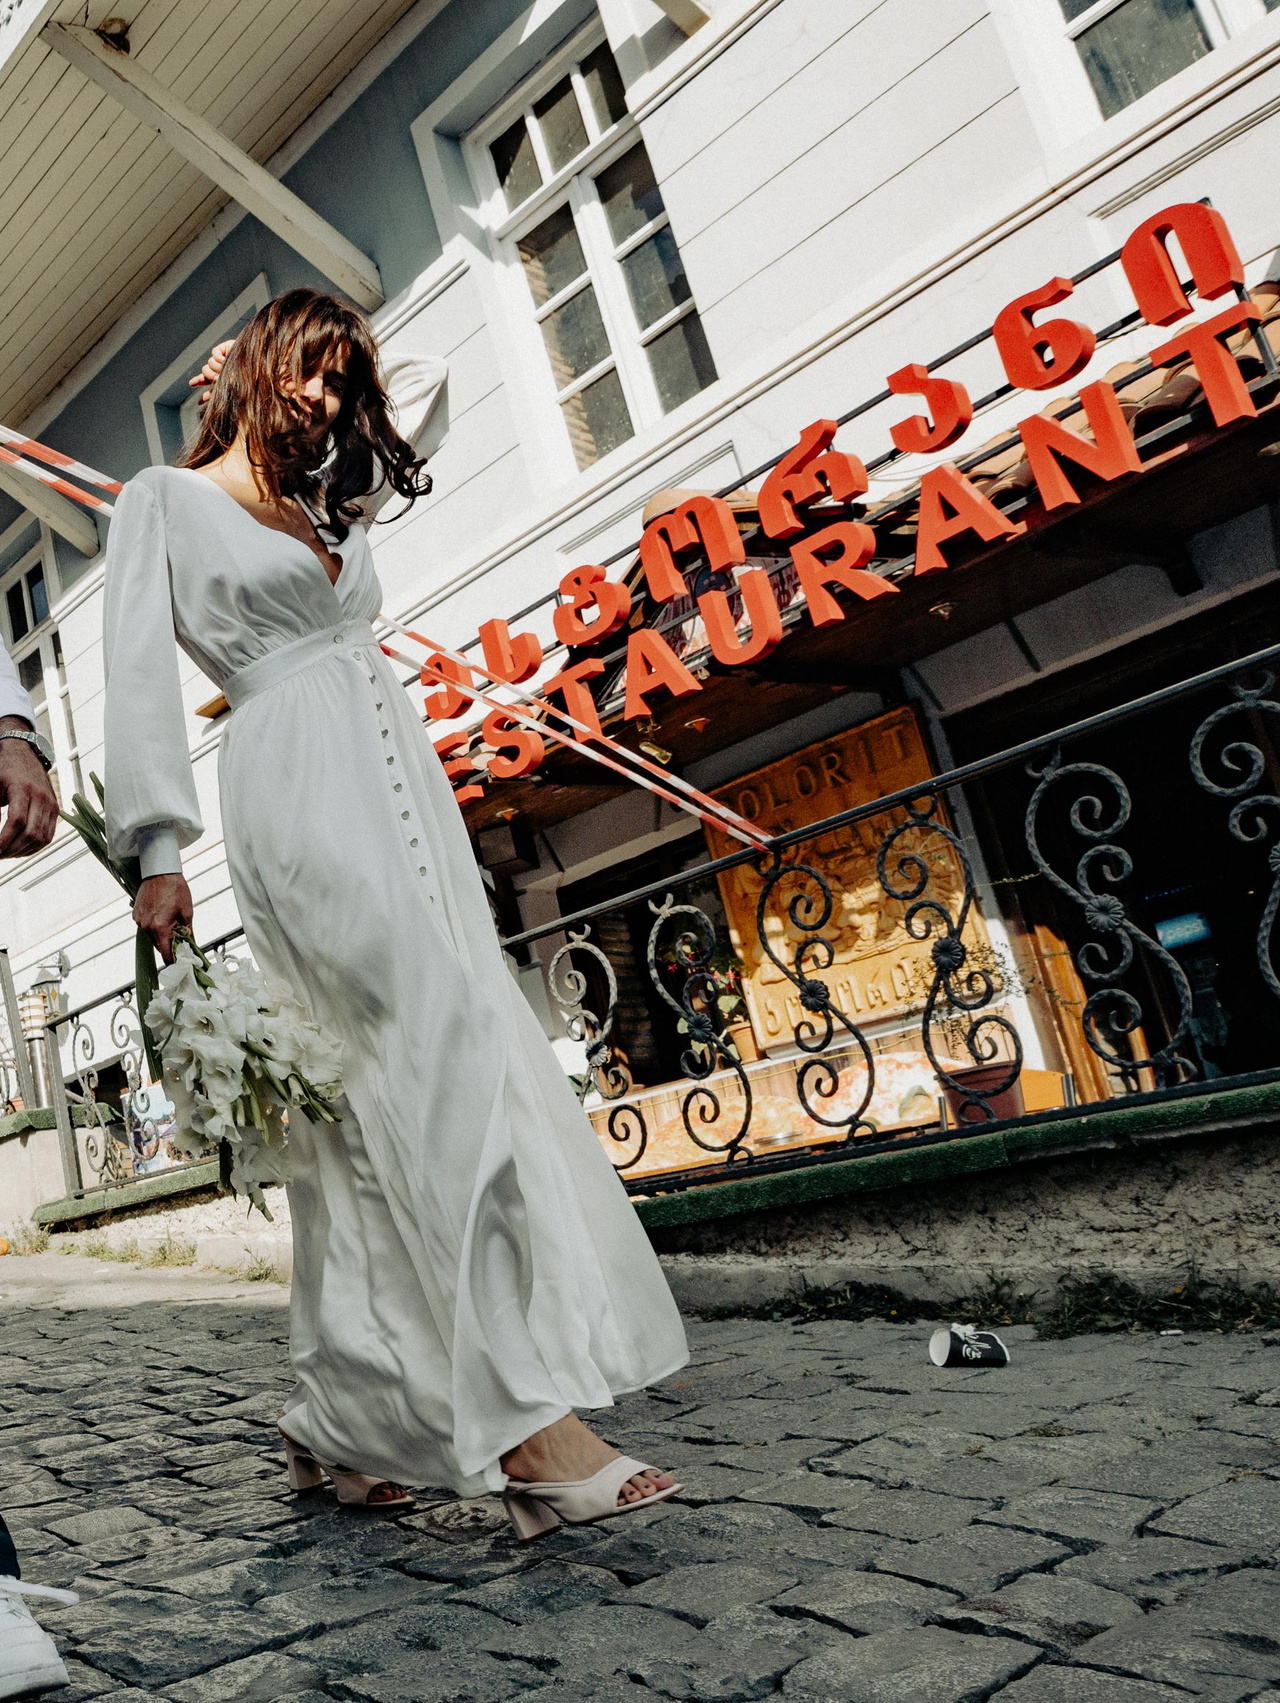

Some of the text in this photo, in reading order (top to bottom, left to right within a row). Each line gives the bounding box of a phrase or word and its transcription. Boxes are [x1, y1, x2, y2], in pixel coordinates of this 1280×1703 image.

[420, 201, 1244, 720] ესტორანი
[431, 300, 1263, 804] ESTAURANT
[722, 722, 908, 822] OLORIT
